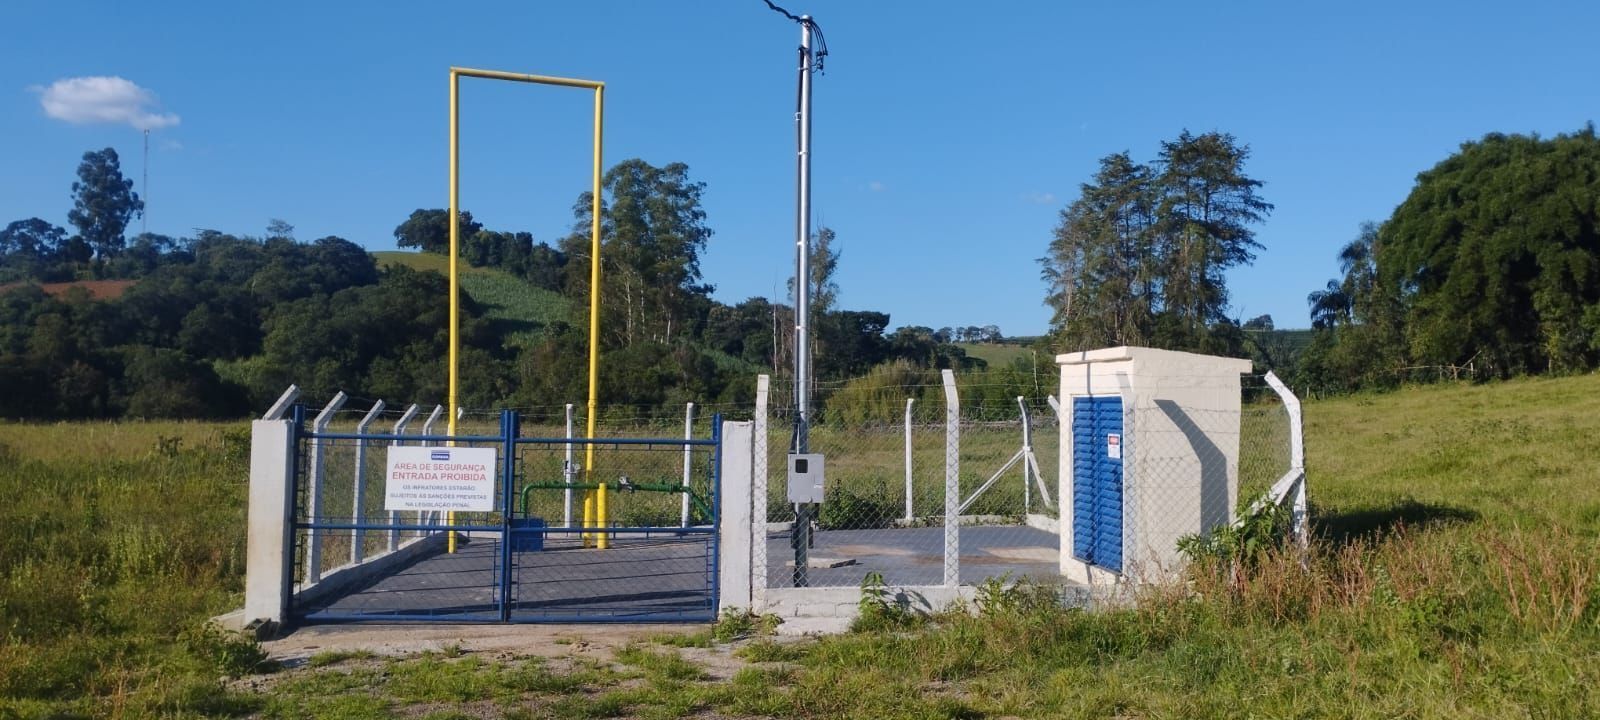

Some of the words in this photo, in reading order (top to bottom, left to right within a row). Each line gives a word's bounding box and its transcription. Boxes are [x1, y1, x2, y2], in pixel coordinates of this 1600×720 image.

[419, 463, 432, 471] DE
[433, 463, 486, 472] SEGURANÇA
[392, 471, 438, 480] ENTRADA
[440, 472, 487, 481] PROIBIDA
